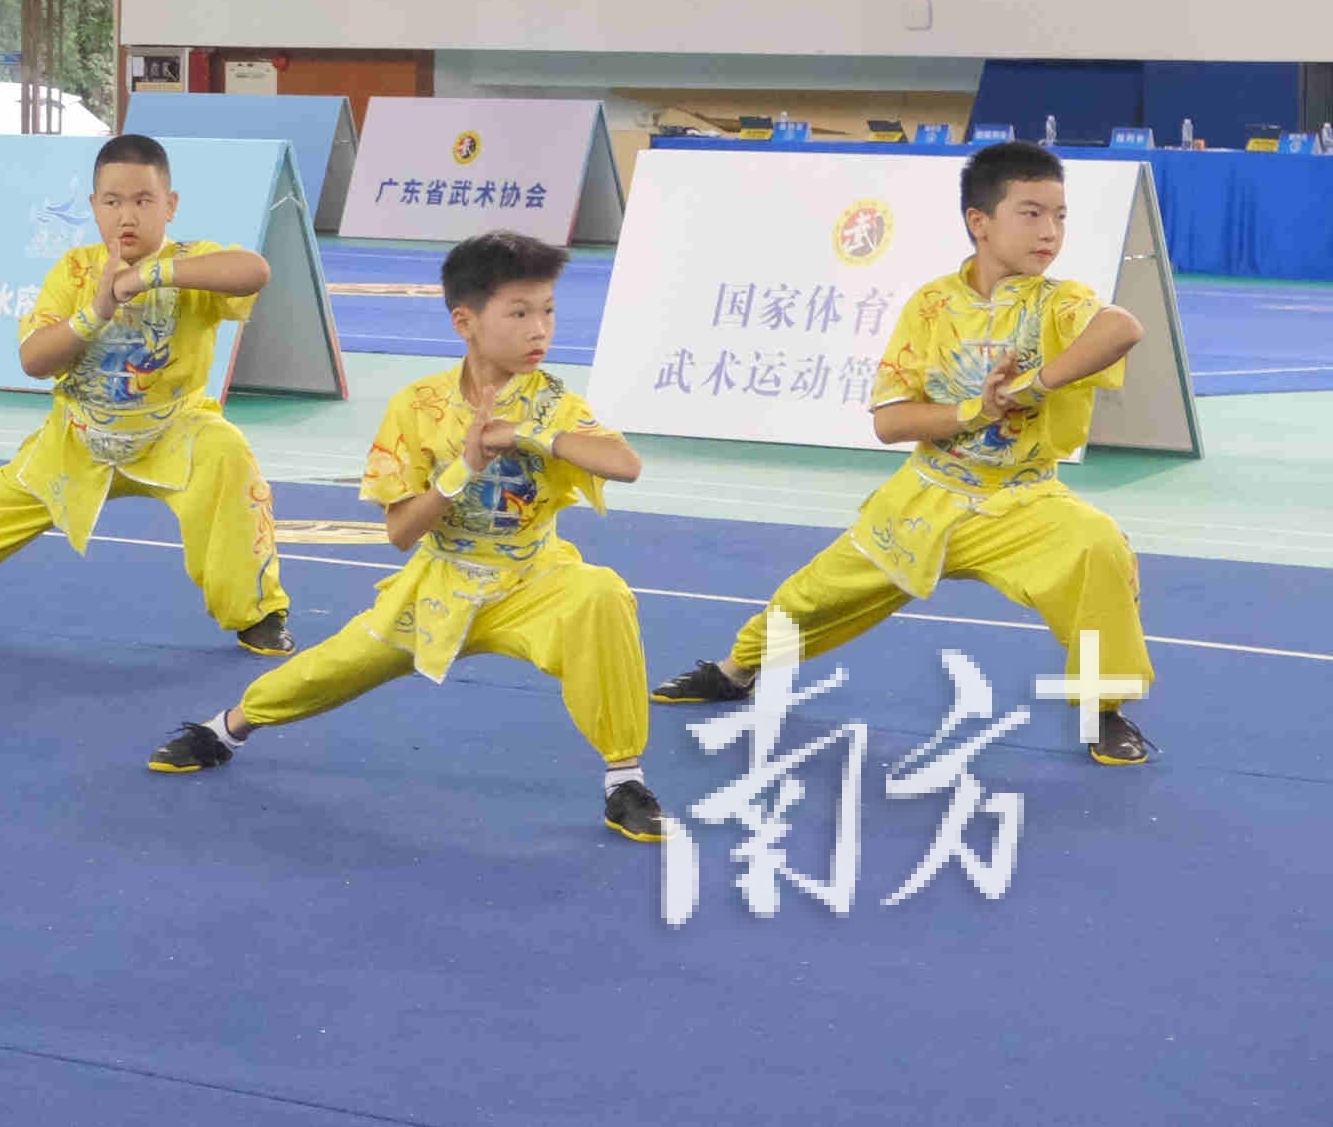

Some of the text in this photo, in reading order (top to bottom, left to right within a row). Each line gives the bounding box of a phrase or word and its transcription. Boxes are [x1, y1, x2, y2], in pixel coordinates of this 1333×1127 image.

[375, 177, 548, 209] 广东省武术协会
[710, 281, 894, 336] 国家体育
